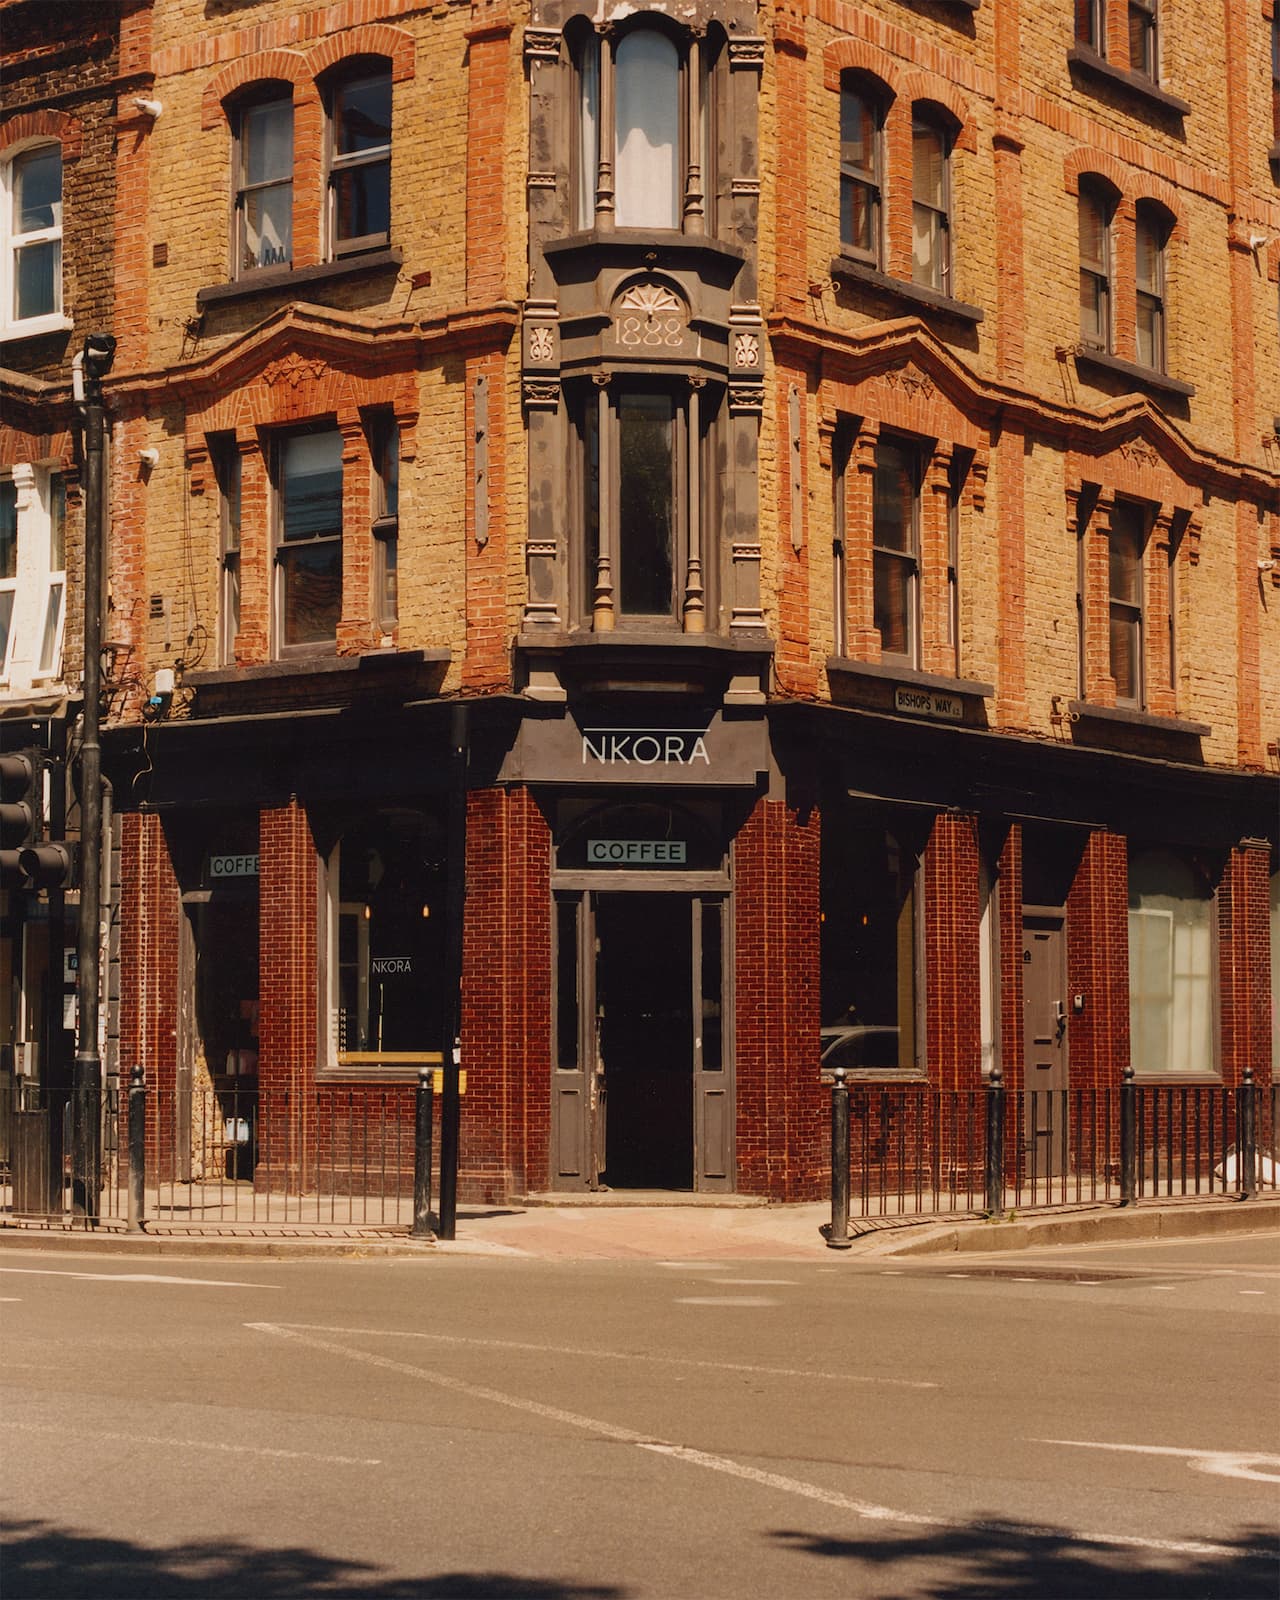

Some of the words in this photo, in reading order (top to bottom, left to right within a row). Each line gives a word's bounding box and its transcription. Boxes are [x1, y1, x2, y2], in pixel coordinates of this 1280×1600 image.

[615, 317, 683, 346] 1888
[934, 697, 952, 713] WAY
[582, 735, 711, 765] NKORA
[593, 843, 681, 860] COFFEE
[214, 857, 260, 874] COFFE
[372, 959, 412, 973] NKORA
